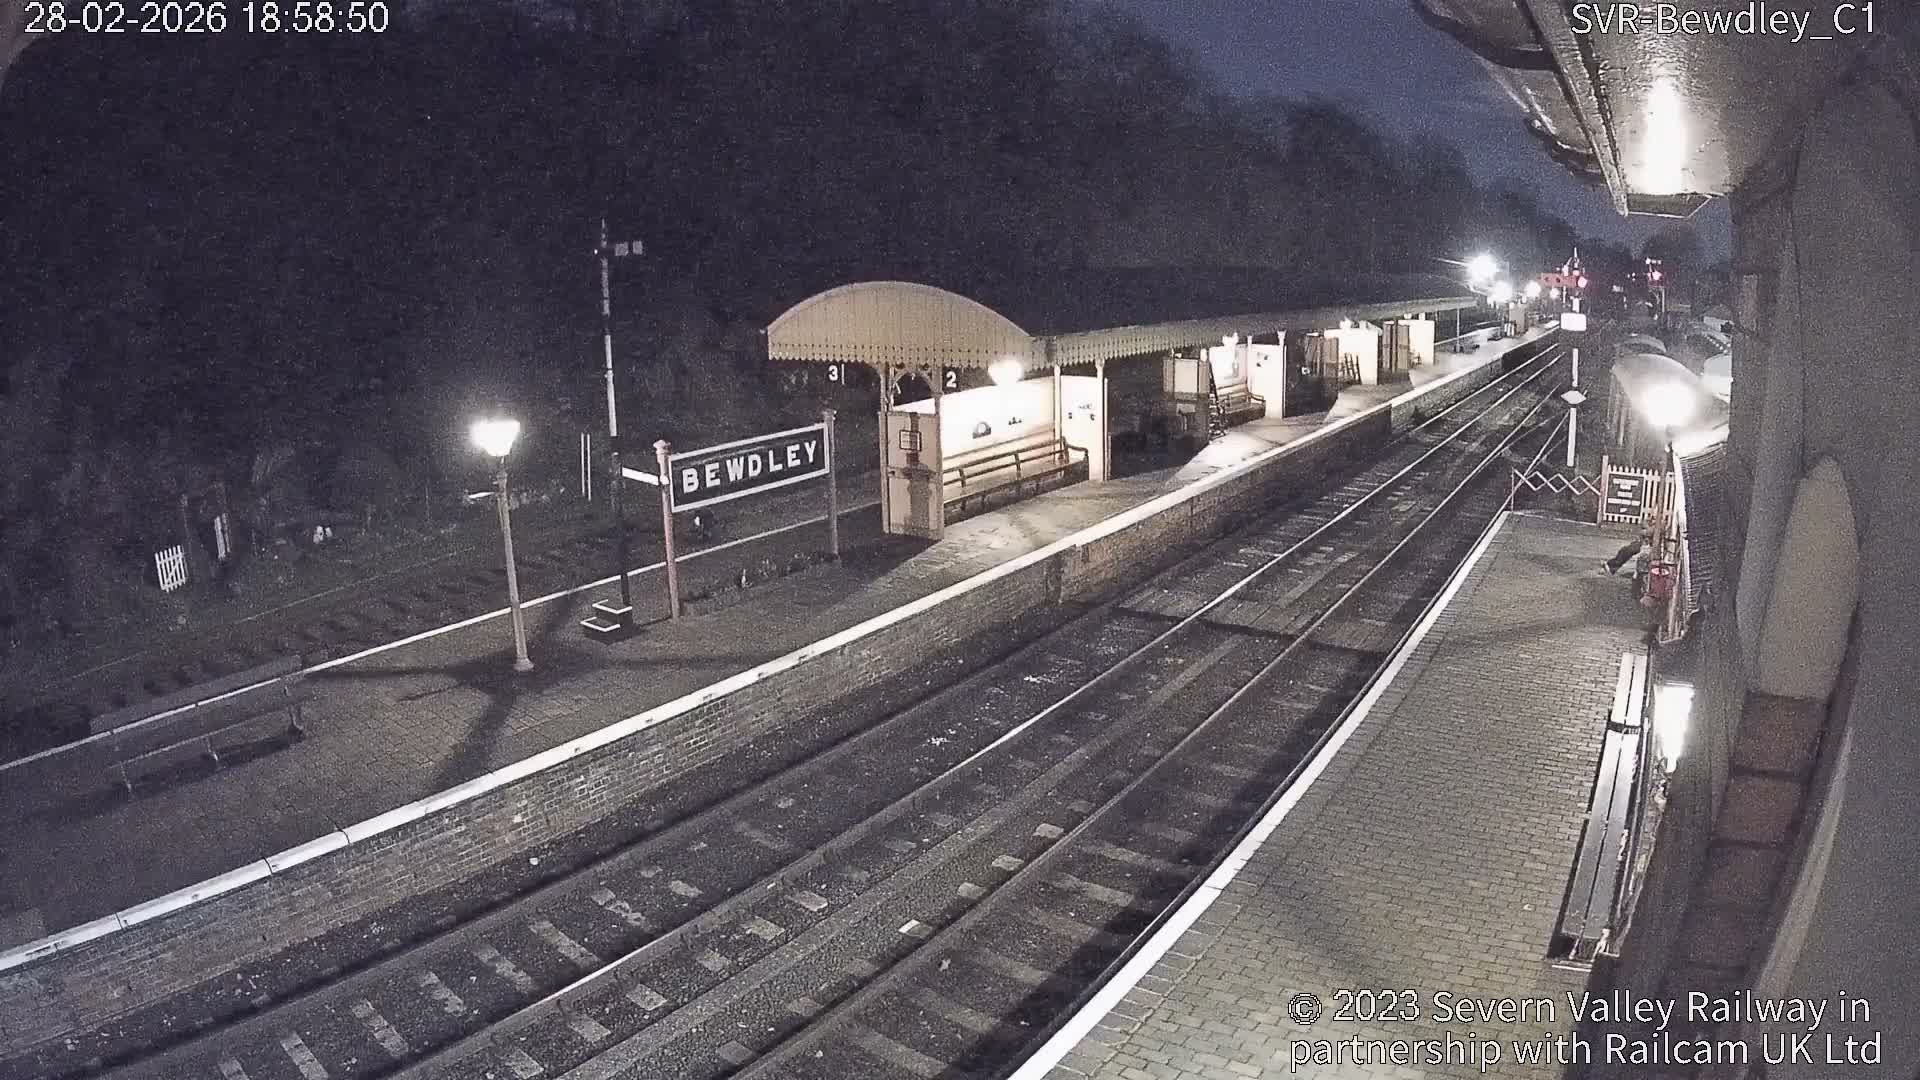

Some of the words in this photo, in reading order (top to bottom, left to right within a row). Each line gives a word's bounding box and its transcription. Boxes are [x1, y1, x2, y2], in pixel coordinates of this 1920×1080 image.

[828, 365, 839, 382] 3
[946, 371, 957, 388] 2
[682, 440, 817, 494] BEWDLEY
